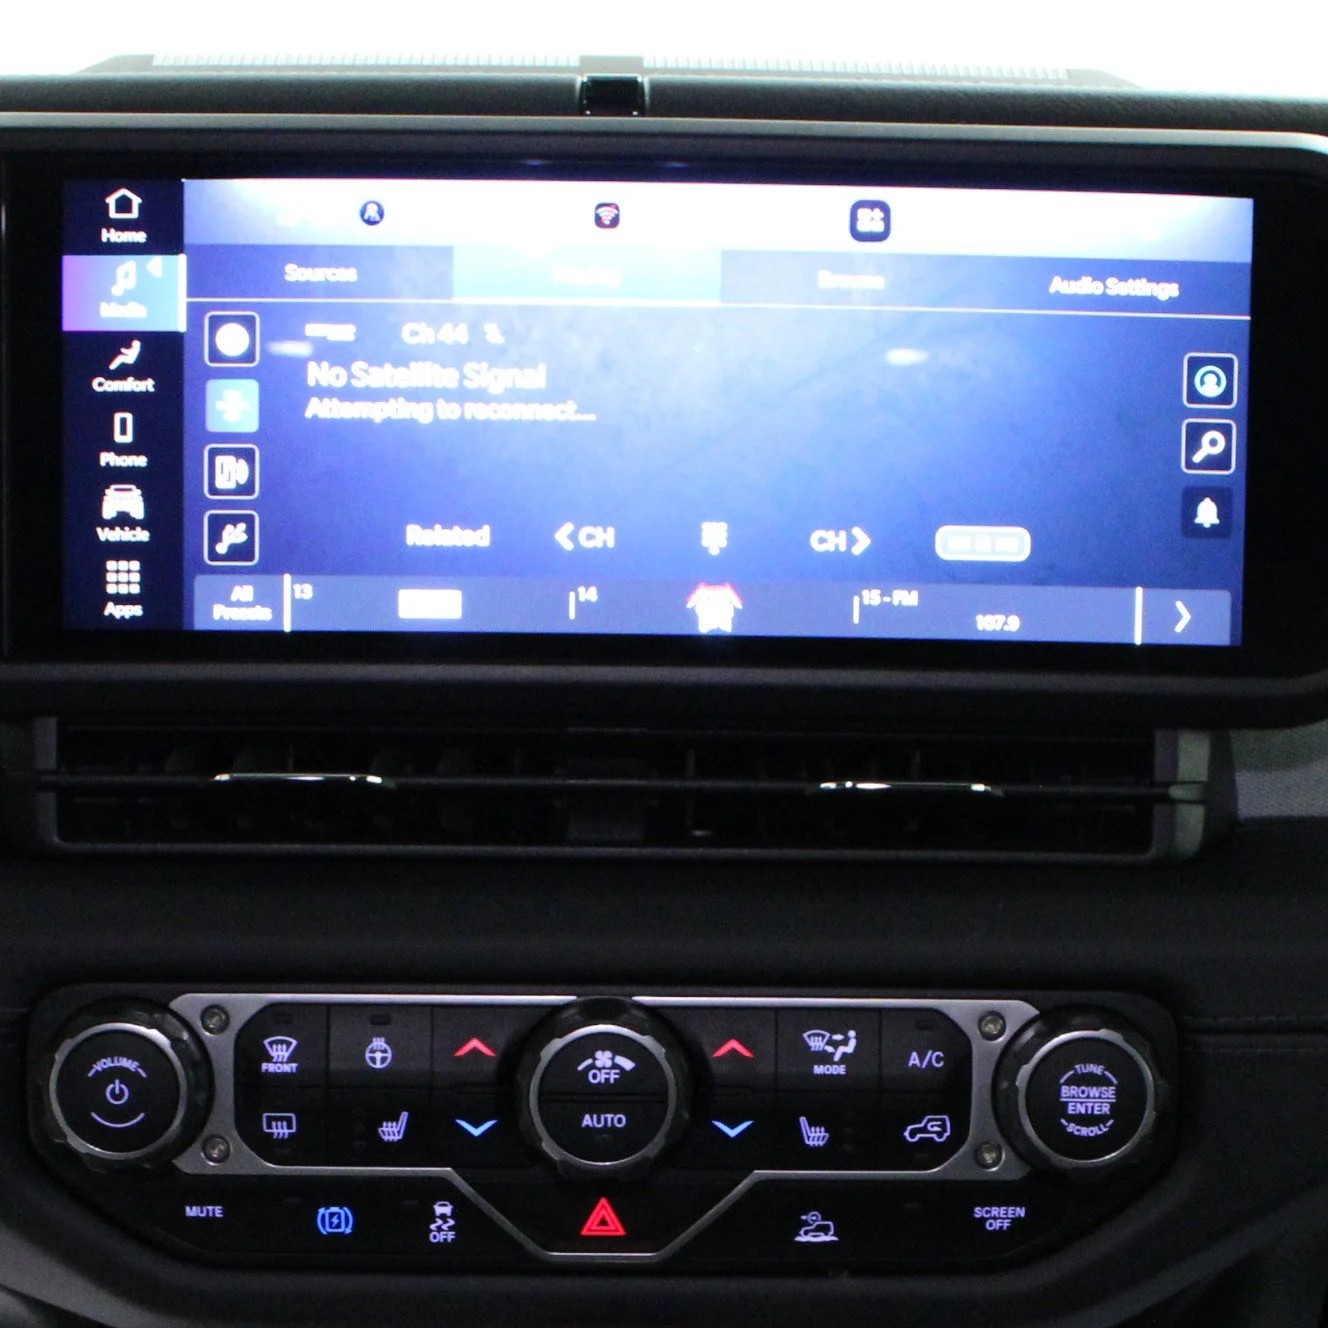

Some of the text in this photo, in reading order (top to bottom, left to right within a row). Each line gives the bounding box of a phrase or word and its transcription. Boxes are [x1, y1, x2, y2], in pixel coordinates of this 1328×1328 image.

[100, 228, 147, 243] Home
[284, 263, 358, 282] Sources
[1048, 275, 1179, 301] Audio Settings
[402, 322, 469, 345] Ch 44
[92, 377, 156, 392] Comfort
[307, 361, 546, 395] No Satellite Signal
[304, 397, 434, 424] Attempting
[435, 399, 461, 420] to
[99, 451, 148, 468] Phone
[96, 527, 151, 542] Vehicle
[405, 524, 490, 547] Related
[578, 526, 615, 548] CH
[810, 529, 846, 553] CH
[292, 583, 314, 600] 13
[577, 586, 598, 603] 14
[103, 602, 144, 619] Apps
[94, 1056, 139, 1074] VOLUME
[262, 1062, 299, 1074] FRONT
[908, 1051, 945, 1069] A/C
[588, 1069, 620, 1084] OFF
[813, 1065, 846, 1075] MODE
[1074, 1063, 1105, 1076] TUNE
[1060, 1085, 1116, 1099] BROWSE
[1067, 1102, 1111, 1115] ENTER
[582, 1114, 627, 1129] AUTO
[1066, 1120, 1109, 1137] SCROLL
[185, 1205, 224, 1218] MUTE
[974, 1206, 1025, 1219] SCREEN
[985, 1219, 1012, 1231] OFF
[429, 1231, 456, 1243] OFF
